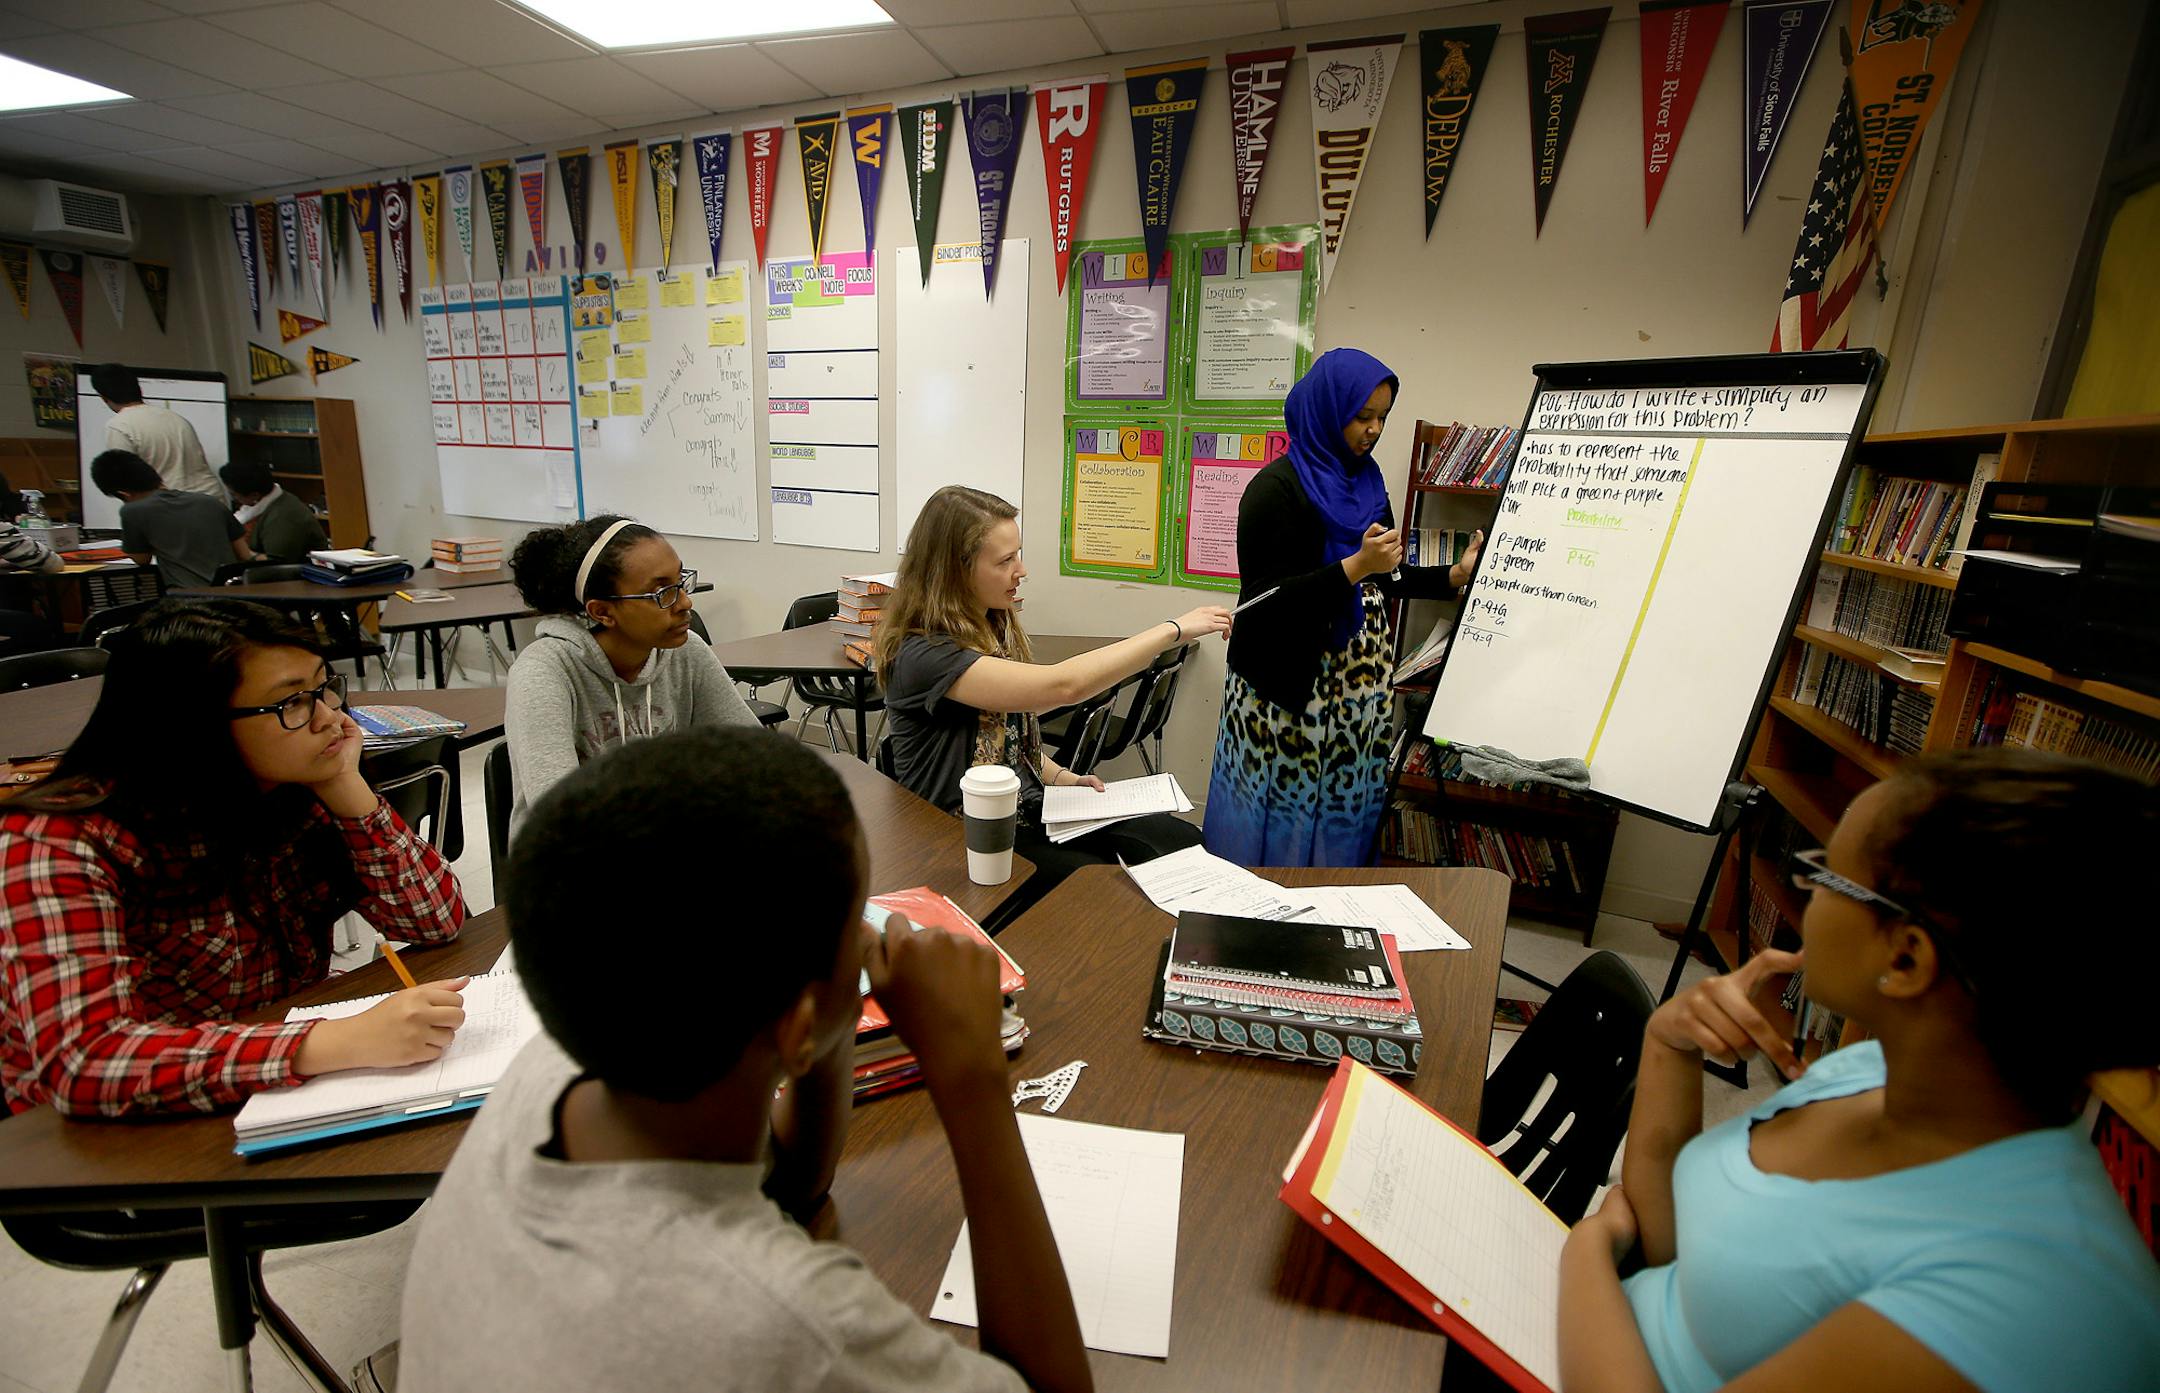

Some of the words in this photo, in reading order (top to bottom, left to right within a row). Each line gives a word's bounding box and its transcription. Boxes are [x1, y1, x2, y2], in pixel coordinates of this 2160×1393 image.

[1665, 10, 1682, 72] WISCONSIN
[1772, 27, 1793, 81] University
[1656, 79, 1680, 127] River
[1769, 81, 1781, 93] of
[1892, 74, 1935, 110] ST.
[1048, 84, 1090, 144] R
[1231, 63, 1254, 183] UNIVERSITY
[1242, 59, 1287, 196] HAMLINE
[1762, 94, 1778, 126] Sioux
[753, 131, 770, 157] M
[855, 118, 882, 168] W
[1151, 117, 1166, 154] EAU
[1165, 115, 1175, 170] UNIVERSITY
[1539, 94, 1563, 186] ROCHESTER
[1649, 132, 1671, 174] Falls
[1757, 128, 1772, 152] Falls
[616, 150, 627, 185] ASU
[809, 158, 827, 200] AVID
[978, 170, 1004, 197] ST.
[700, 176, 715, 246] UNIVERSITY
[714, 173, 725, 239] FINLANDIA
[754, 161, 762, 229] MOORHEAD
[1057, 147, 1074, 252] RUTGERS
[1146, 159, 1164, 226] CLAIRE
[1160, 175, 1170, 226] WISCONSIN
[1316, 126, 1373, 255] DULUTH
[280, 201, 298, 268] STOUT
[488, 192, 506, 267] CARLETON
[981, 199, 1000, 266] THOMAS
[770, 265, 786, 279] THIS
[847, 268, 872, 282] FOCUS
[1206, 286, 1247, 302] Inquiry
[1085, 292, 1125, 305] Writing
[39, 404, 75, 421] Live
[1568, 391, 1605, 410] How
[1605, 390, 1625, 408] do
[1646, 389, 1697, 406] write
[1714, 386, 1792, 412] simplify
[1800, 386, 1828, 403] an
[1607, 411, 1631, 428] for
[1635, 408, 1665, 427] this
[1080, 463, 1145, 477] Collaboration
[1560, 441, 1571, 456] to
[1575, 443, 1645, 460] represent
[1649, 444, 1680, 462] the
[1196, 469, 1239, 485] Reading
[1507, 479, 1528, 495] will
[1560, 487, 1569, 499] a
[1624, 487, 1664, 508] purple
[1594, 463, 1628, 481] that
[1630, 466, 1687, 483] someone
